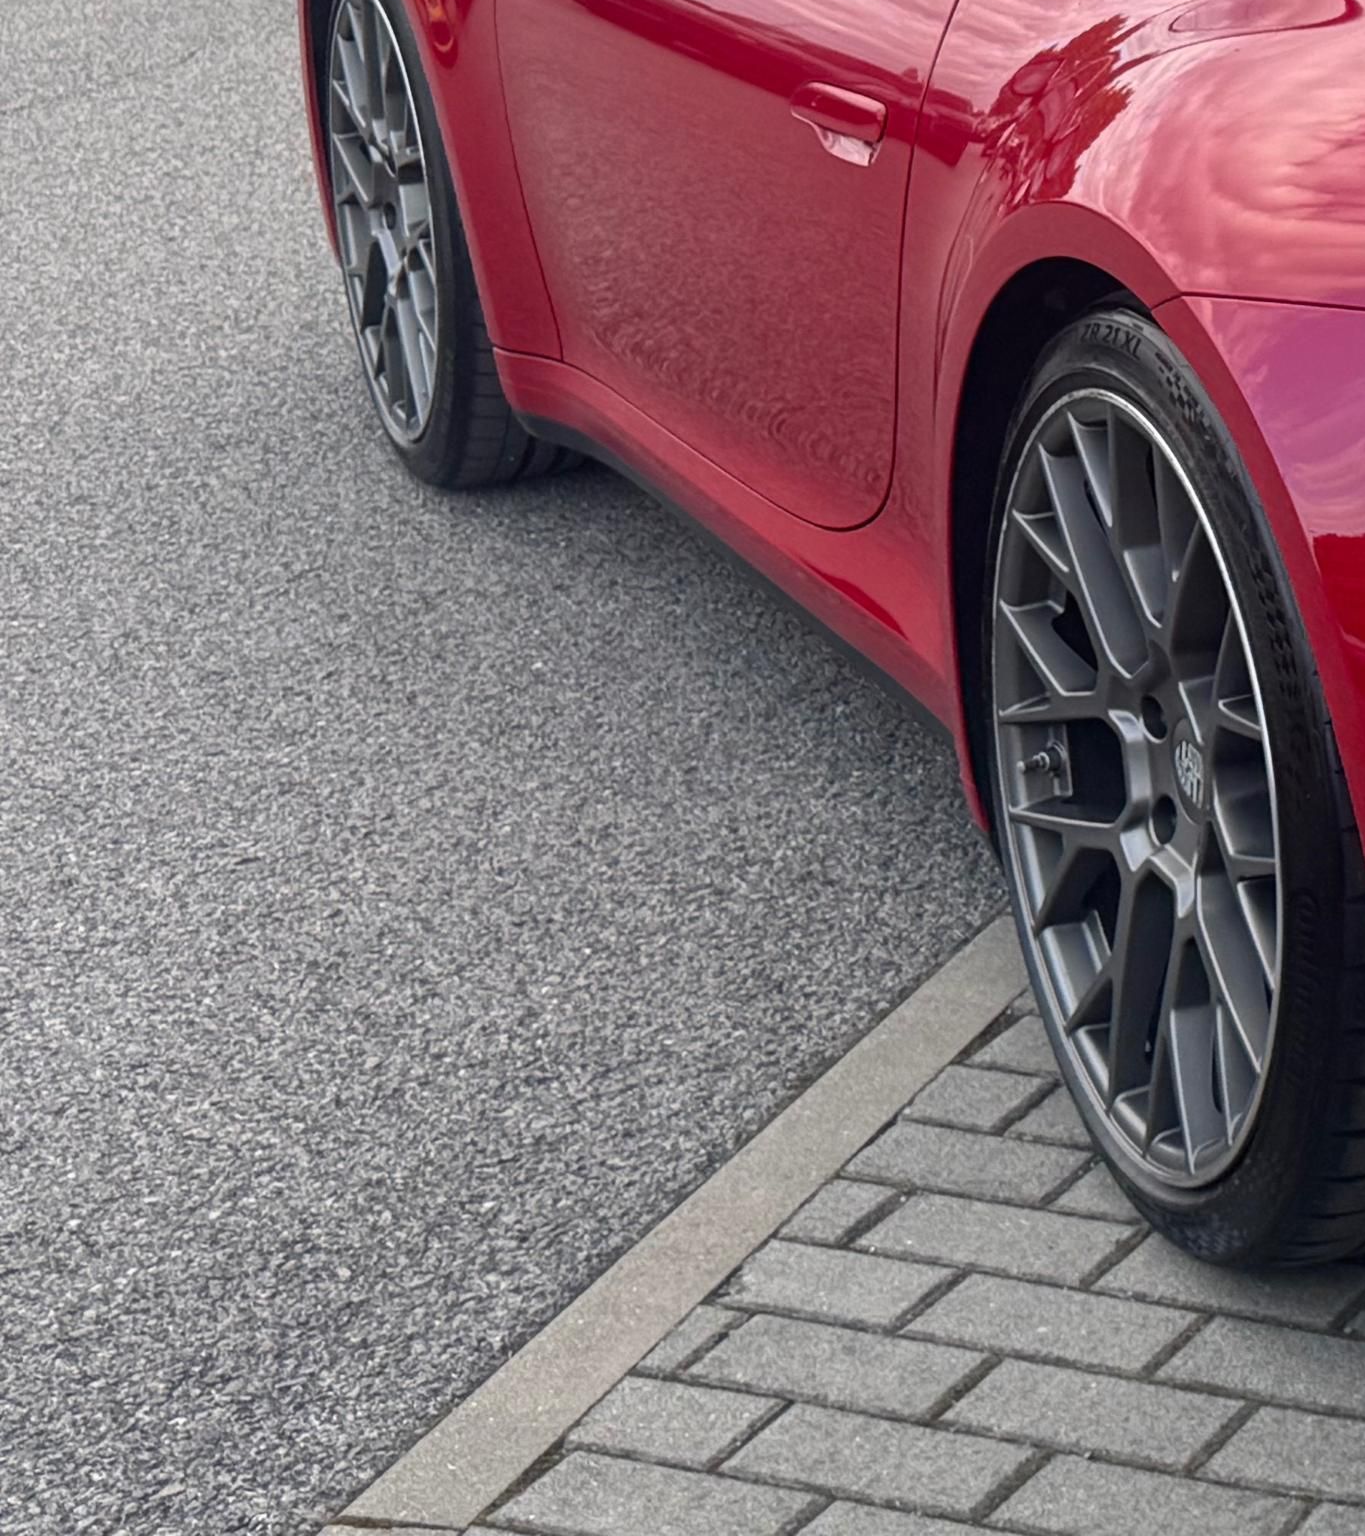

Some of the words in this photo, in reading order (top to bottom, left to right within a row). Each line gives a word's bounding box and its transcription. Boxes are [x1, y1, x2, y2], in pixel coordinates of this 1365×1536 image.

[1081, 322, 1100, 343] ZR
[1101, 324, 1121, 345] 21
[1121, 330, 1142, 361] XL
